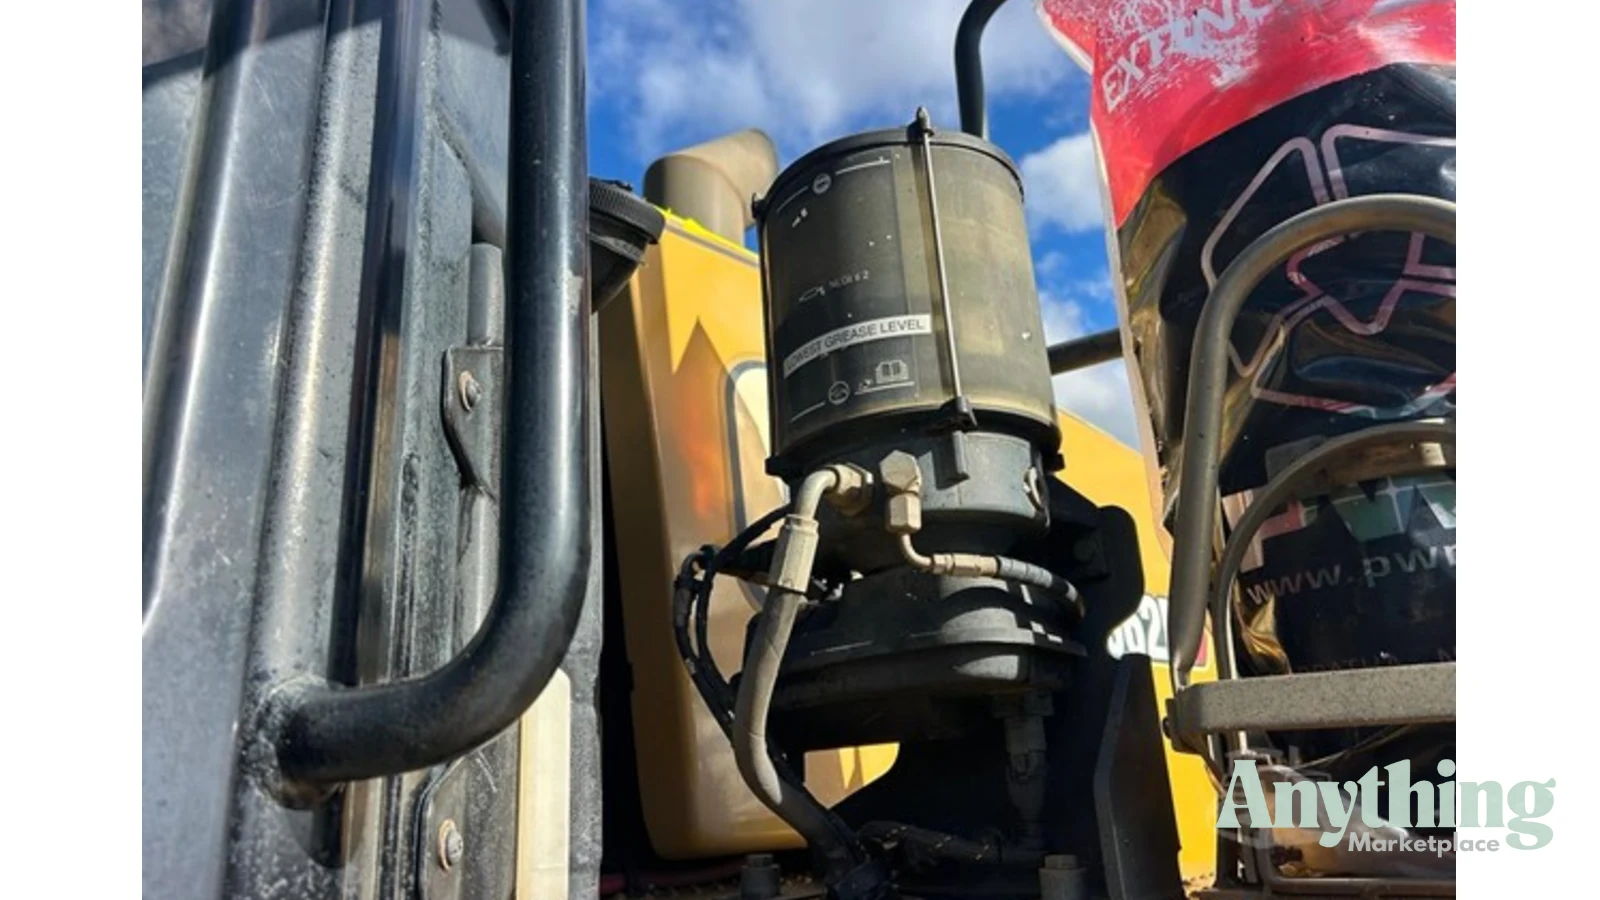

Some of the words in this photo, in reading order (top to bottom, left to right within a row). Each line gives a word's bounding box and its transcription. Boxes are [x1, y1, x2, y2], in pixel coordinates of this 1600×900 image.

[785, 340, 822, 371] LOWEST
[824, 323, 878, 348] GREASE
[880, 319, 924, 333] LEVEL
